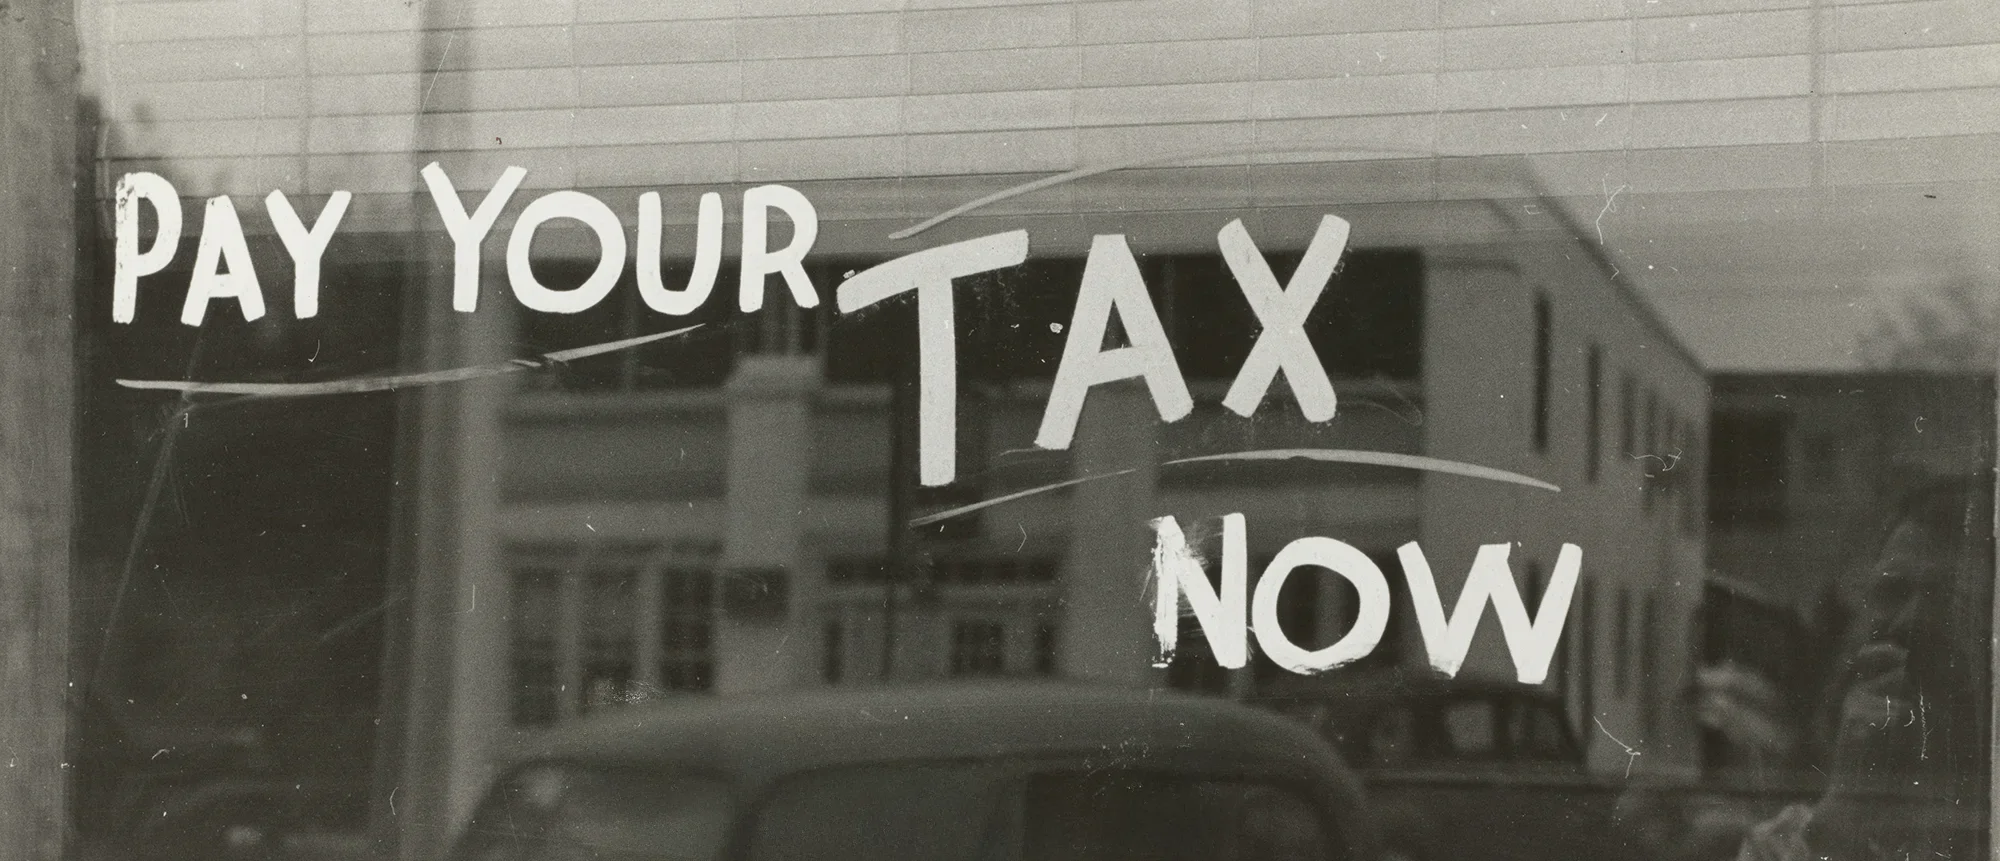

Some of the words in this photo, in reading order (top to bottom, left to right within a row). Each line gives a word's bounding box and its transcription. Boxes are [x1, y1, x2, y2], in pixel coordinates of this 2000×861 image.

[113, 172, 352, 326] PAY
[420, 161, 819, 315] YOUR
[837, 214, 1351, 487] TAX
[1152, 513, 1583, 685] NOW
